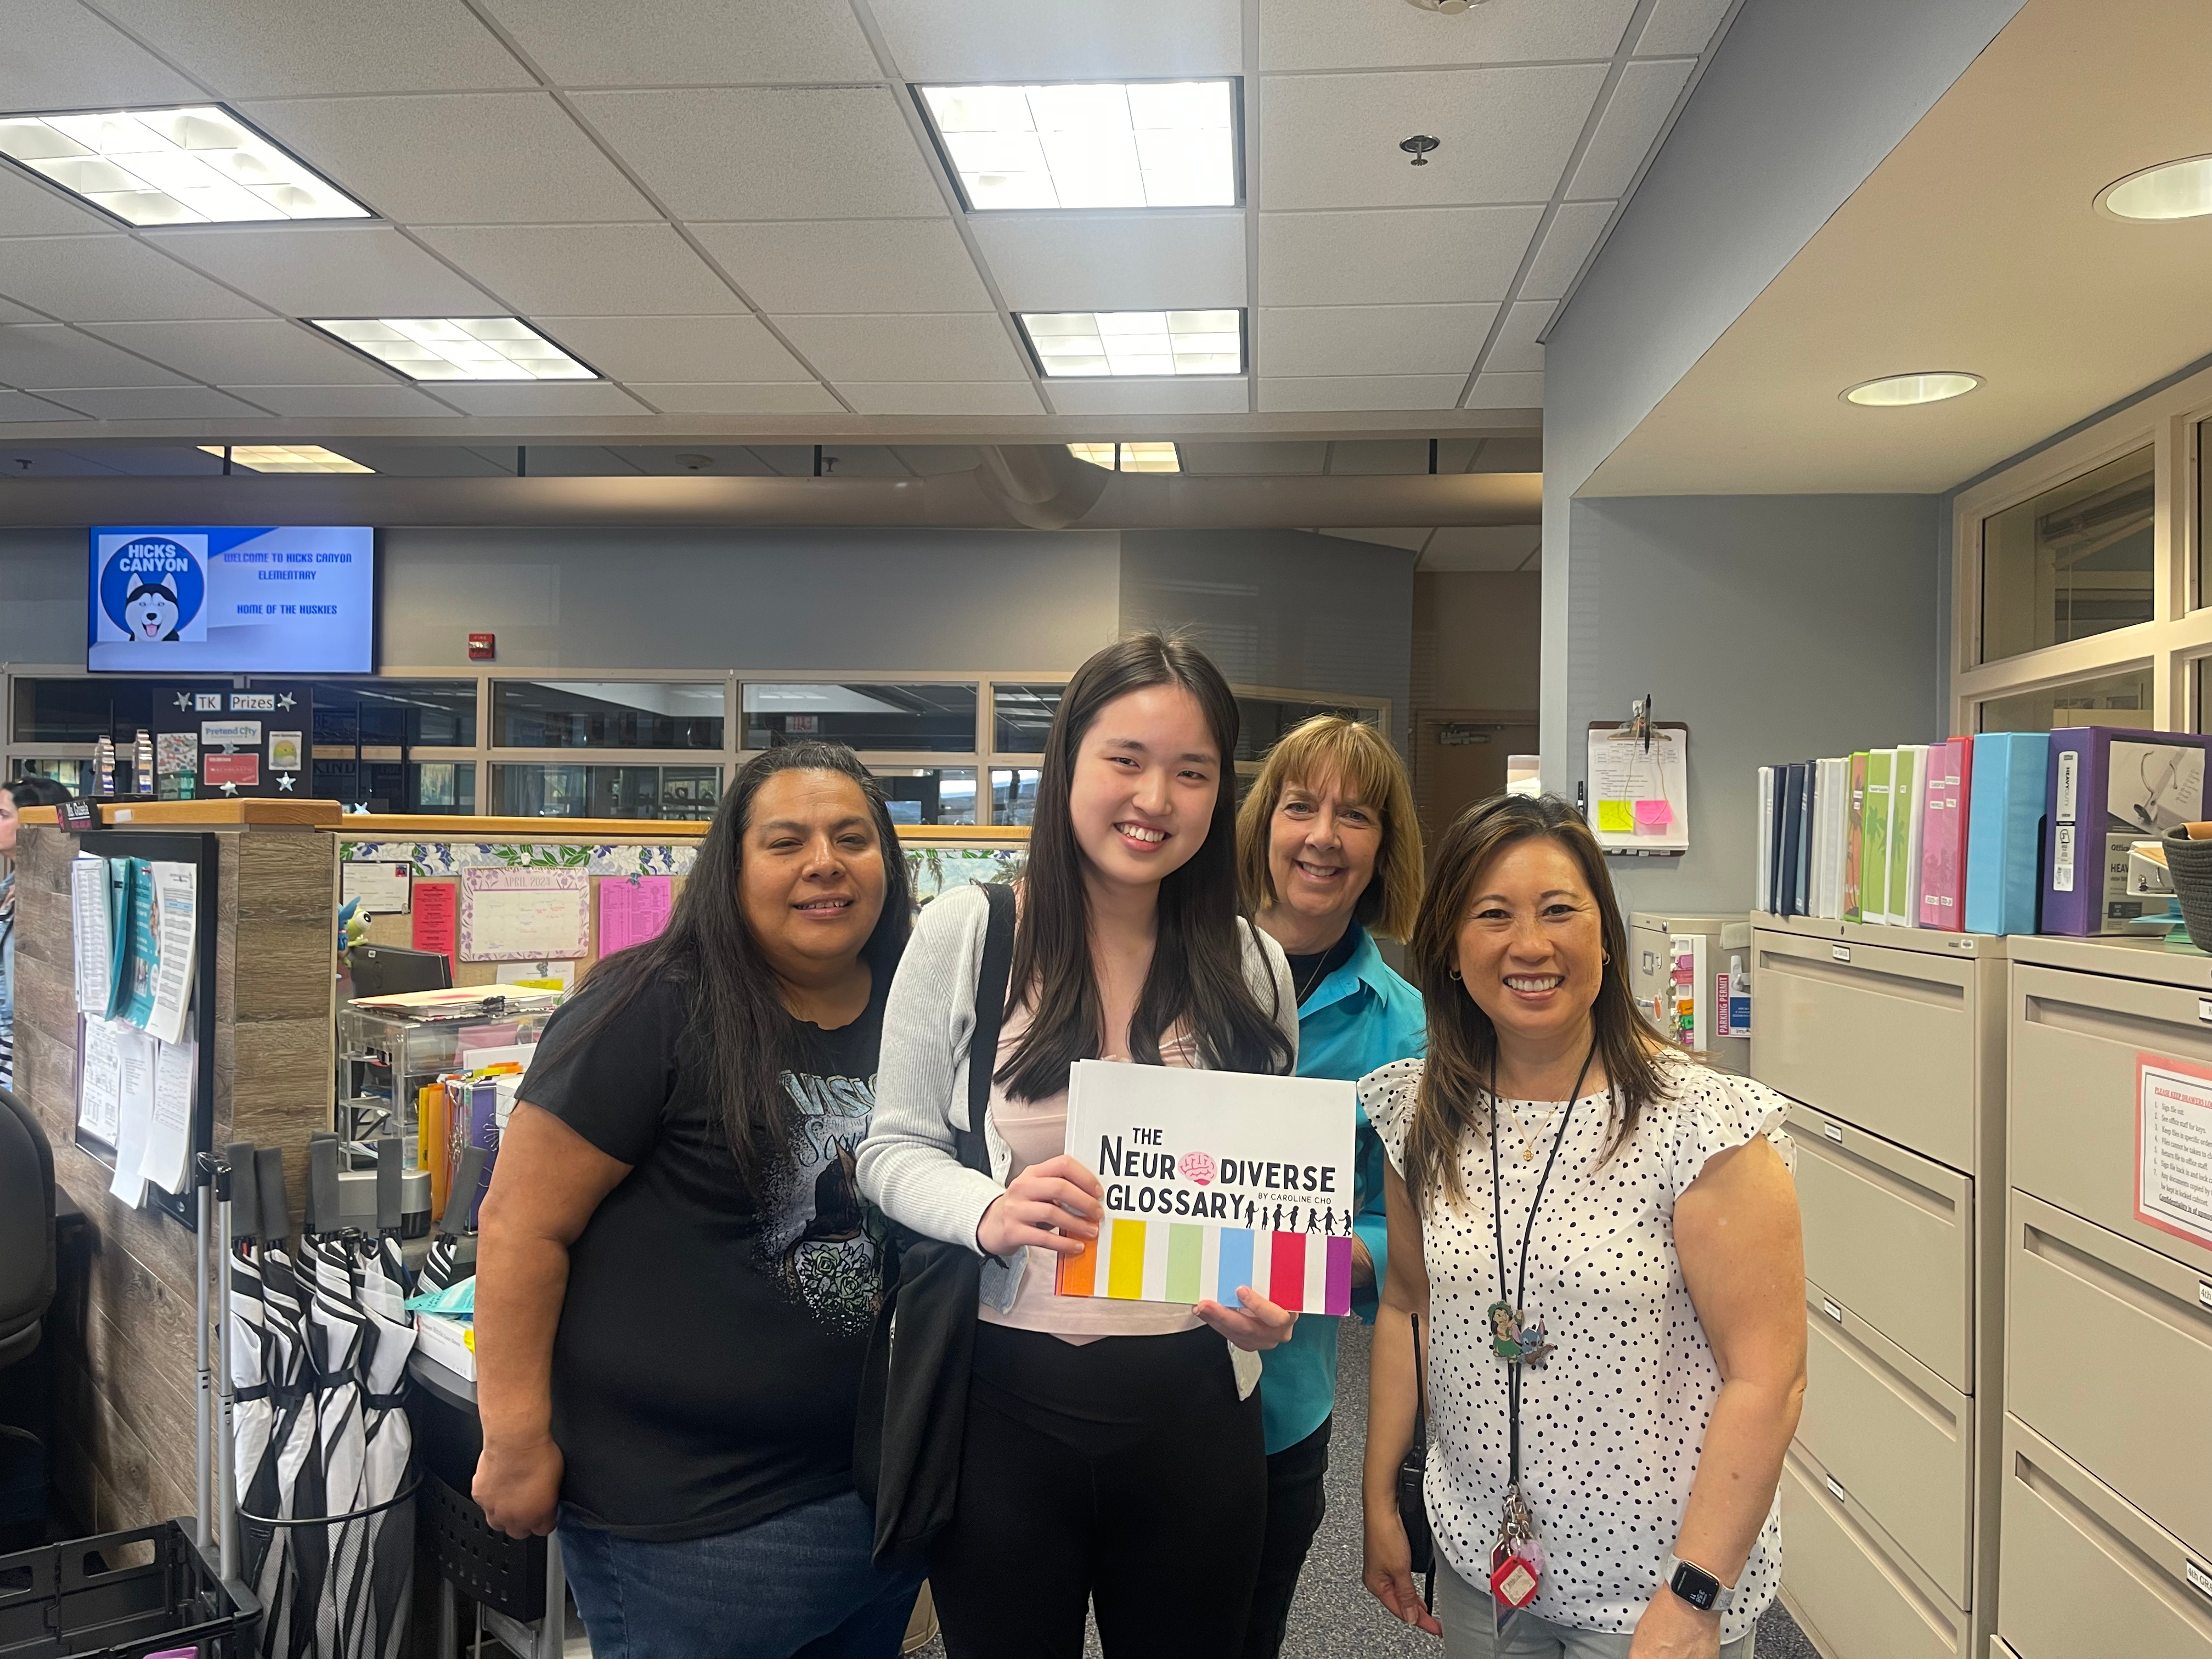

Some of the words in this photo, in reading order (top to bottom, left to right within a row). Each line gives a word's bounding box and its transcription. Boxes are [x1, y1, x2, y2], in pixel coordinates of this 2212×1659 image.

[128, 545, 176, 558] HICKS
[224, 553, 269, 563] WELCOME
[273, 554, 284, 563] TO
[286, 554, 313, 563] HICKS
[120, 558, 188, 572] CANYON
[258, 571, 317, 580] ELEMENTARY
[237, 605, 263, 614] HOME
[266, 605, 276, 614] OF
[281, 605, 297, 614] THE
[300, 605, 337, 615] HUSKIES
[198, 696, 217, 709] TK
[233, 696, 273, 710] Prizes
[240, 727, 257, 738] City
[504, 877, 527, 887] APRIL
[1719, 977, 1728, 1002] PERMIT
[1719, 1003, 1728, 1033] PARKING
[1132, 1128, 1163, 1146] THE
[1105, 1184, 1245, 1220] GLOSSARY
[1271, 1193, 1312, 1204] CAROLINE
[2188, 1567, 2198, 1581] 4th
